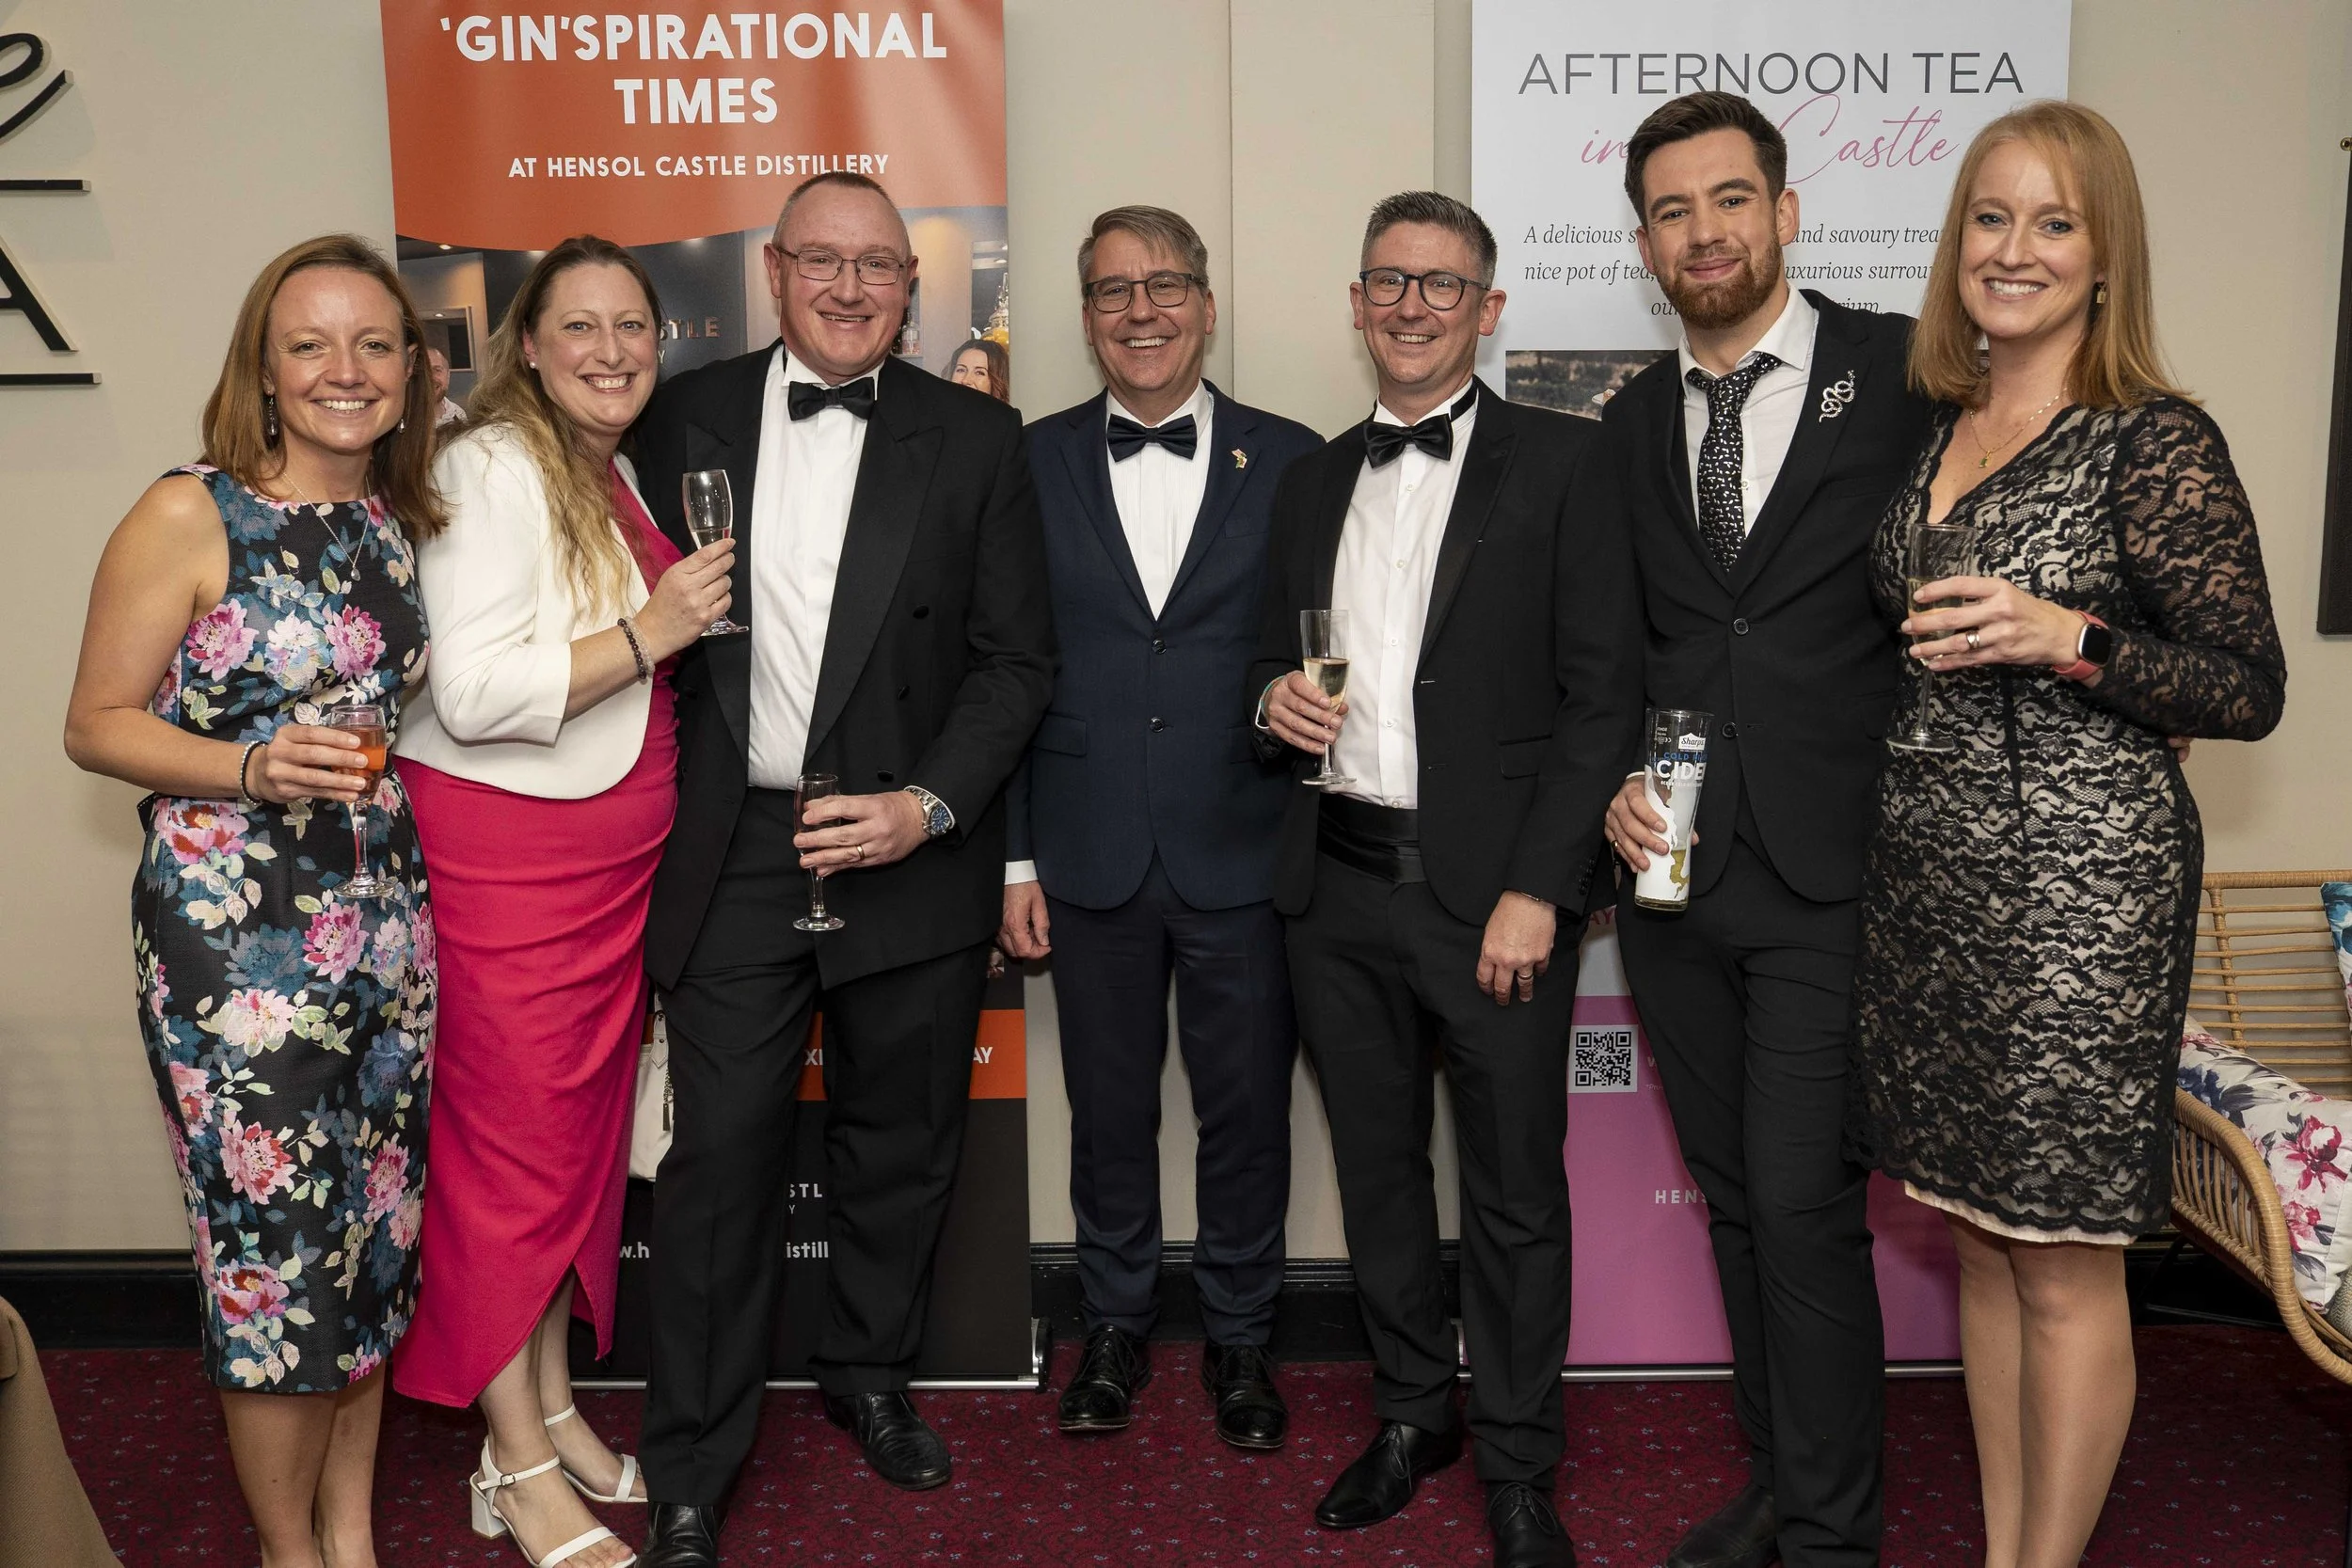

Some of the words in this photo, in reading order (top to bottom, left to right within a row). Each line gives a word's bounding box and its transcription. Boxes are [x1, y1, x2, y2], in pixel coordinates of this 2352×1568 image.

[440, 12, 947, 61] 'GIN'SPIRATIONAL
[1518, 52, 1888, 94] AFTERNOON
[1913, 52, 2024, 93] TEA
[613, 77, 778, 124] TIMES
[1777, 93, 1960, 185] Castle
[508, 157, 537, 178] AT
[548, 157, 645, 177] HENSOL
[656, 155, 746, 176] CASTLE
[756, 153, 889, 175] DISTILLERY
[1523, 226, 1537, 244] A
[1543, 224, 1622, 244] delicious
[1829, 230, 1900, 249] savoury
[1904, 227, 1940, 244] trea
[1524, 261, 1562, 280] nice
[1565, 264, 1597, 286] pot
[1600, 260, 1620, 286] of
[1786, 261, 1864, 279] uxurious
[1867, 264, 1931, 279] surrou
[1656, 760, 1707, 780] CIDE
